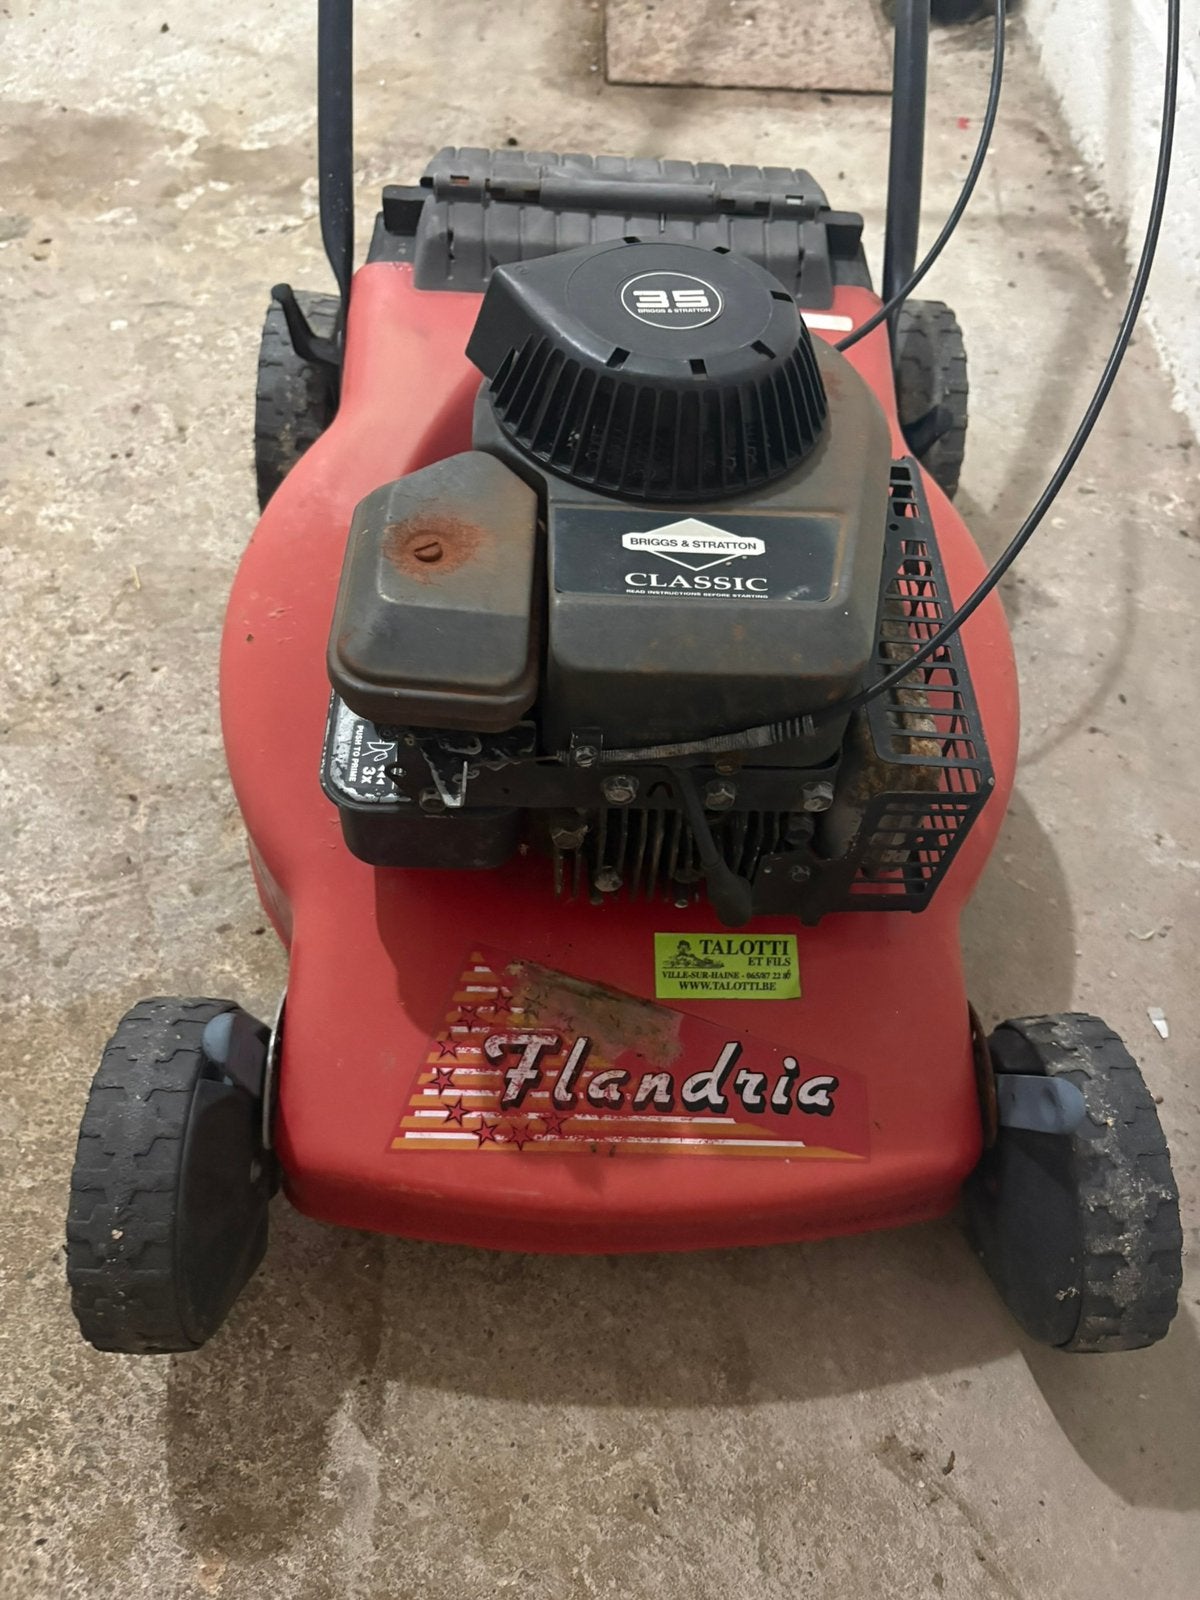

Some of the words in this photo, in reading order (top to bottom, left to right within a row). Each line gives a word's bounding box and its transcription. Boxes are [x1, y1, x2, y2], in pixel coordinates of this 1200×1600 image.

[633, 290, 709, 308] 35
[630, 537, 678, 547] BRIGGS
[681, 540, 690, 548] &
[692, 540, 757, 550] STRATTON
[624, 573, 768, 591] CLASSIC
[354, 725, 364, 745] PUSH
[352, 746, 361, 758] TO
[349, 758, 359, 782] PRIME
[699, 939, 789, 956] TALOTTI
[748, 957, 762, 966] ET
[766, 957, 791, 967] FILS
[662, 971, 740, 979] VILLE-SUR-HAINE
[679, 981, 776, 991] WWW.TALOTTI.BE
[484, 1035, 839, 1116] Flandria
